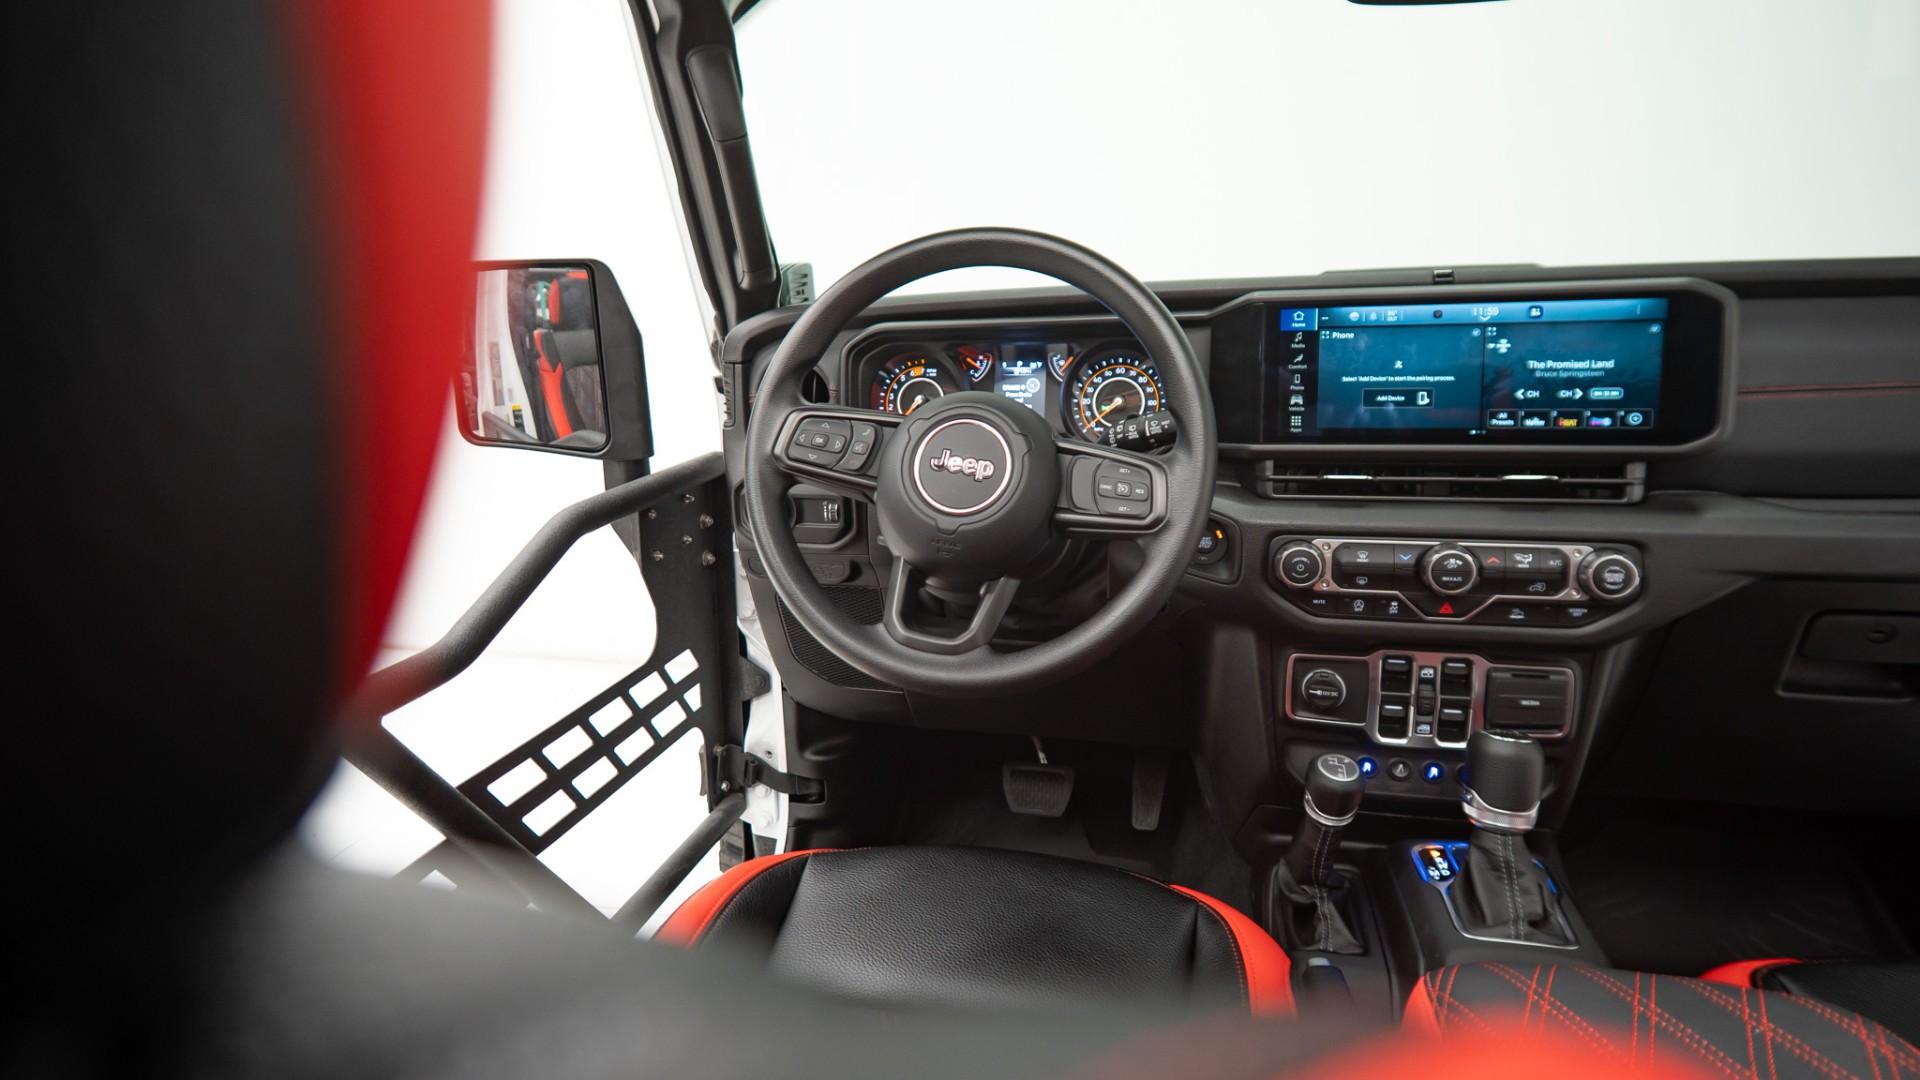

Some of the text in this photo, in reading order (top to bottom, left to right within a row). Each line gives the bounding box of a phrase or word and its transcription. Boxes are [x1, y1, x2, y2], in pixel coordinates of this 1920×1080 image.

[1473, 306, 1499, 316] 11:59
[1332, 331, 1355, 339] Phone
[1527, 359, 1615, 369] The Promised Land
[1559, 370, 1605, 378] Springsteen
[1490, 418, 1515, 426] Presets
[930, 448, 995, 481] Jeep
